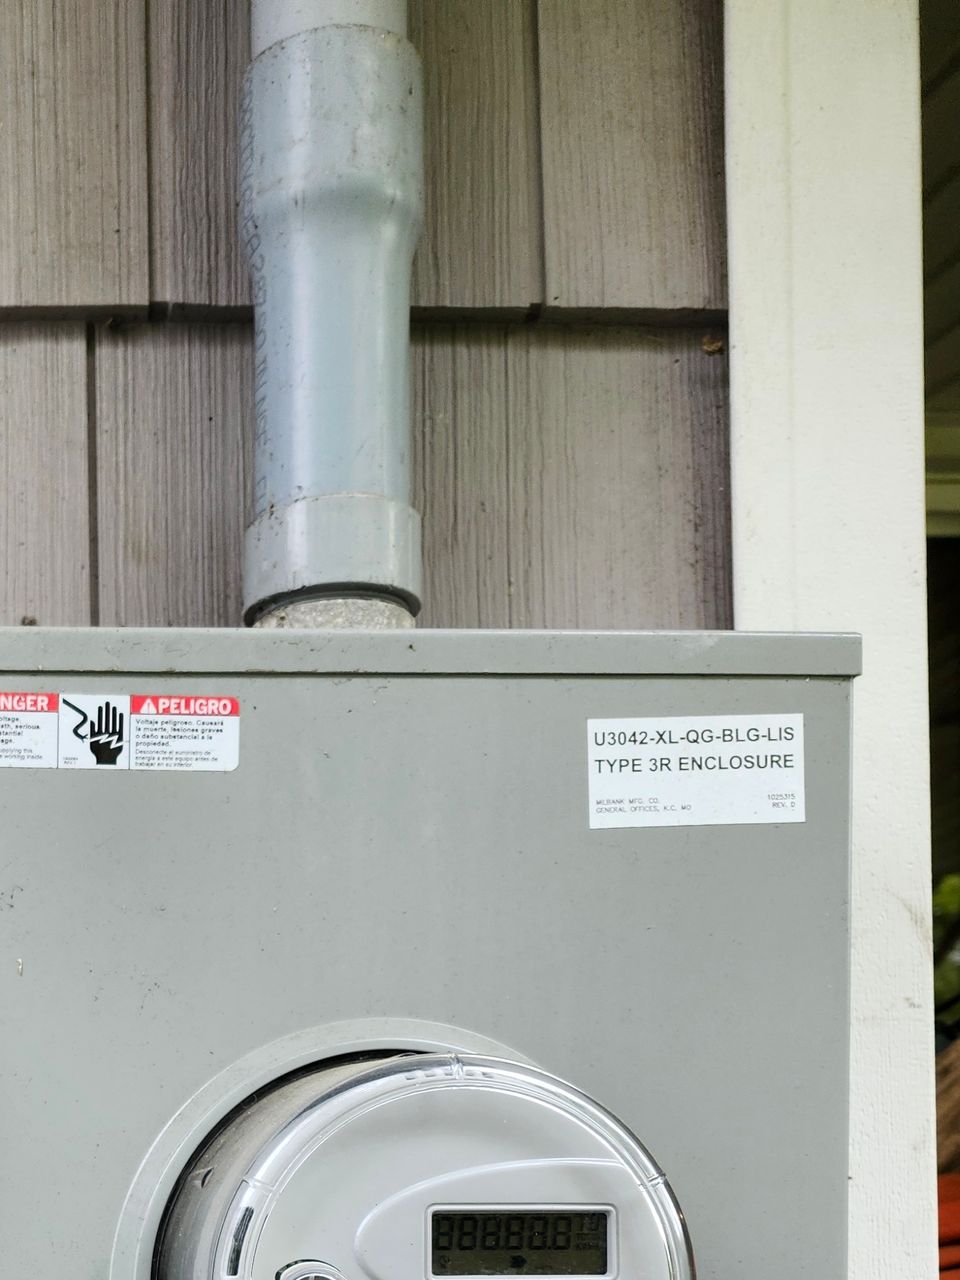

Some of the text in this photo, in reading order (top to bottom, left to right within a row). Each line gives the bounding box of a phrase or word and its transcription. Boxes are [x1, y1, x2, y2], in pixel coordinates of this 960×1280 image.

[158, 698, 232, 715] PELIGRO
[594, 727, 795, 746] U3042-XL-QG-BLG-LIS
[594, 753, 795, 774] TYPE 3R ENCLOSURE
